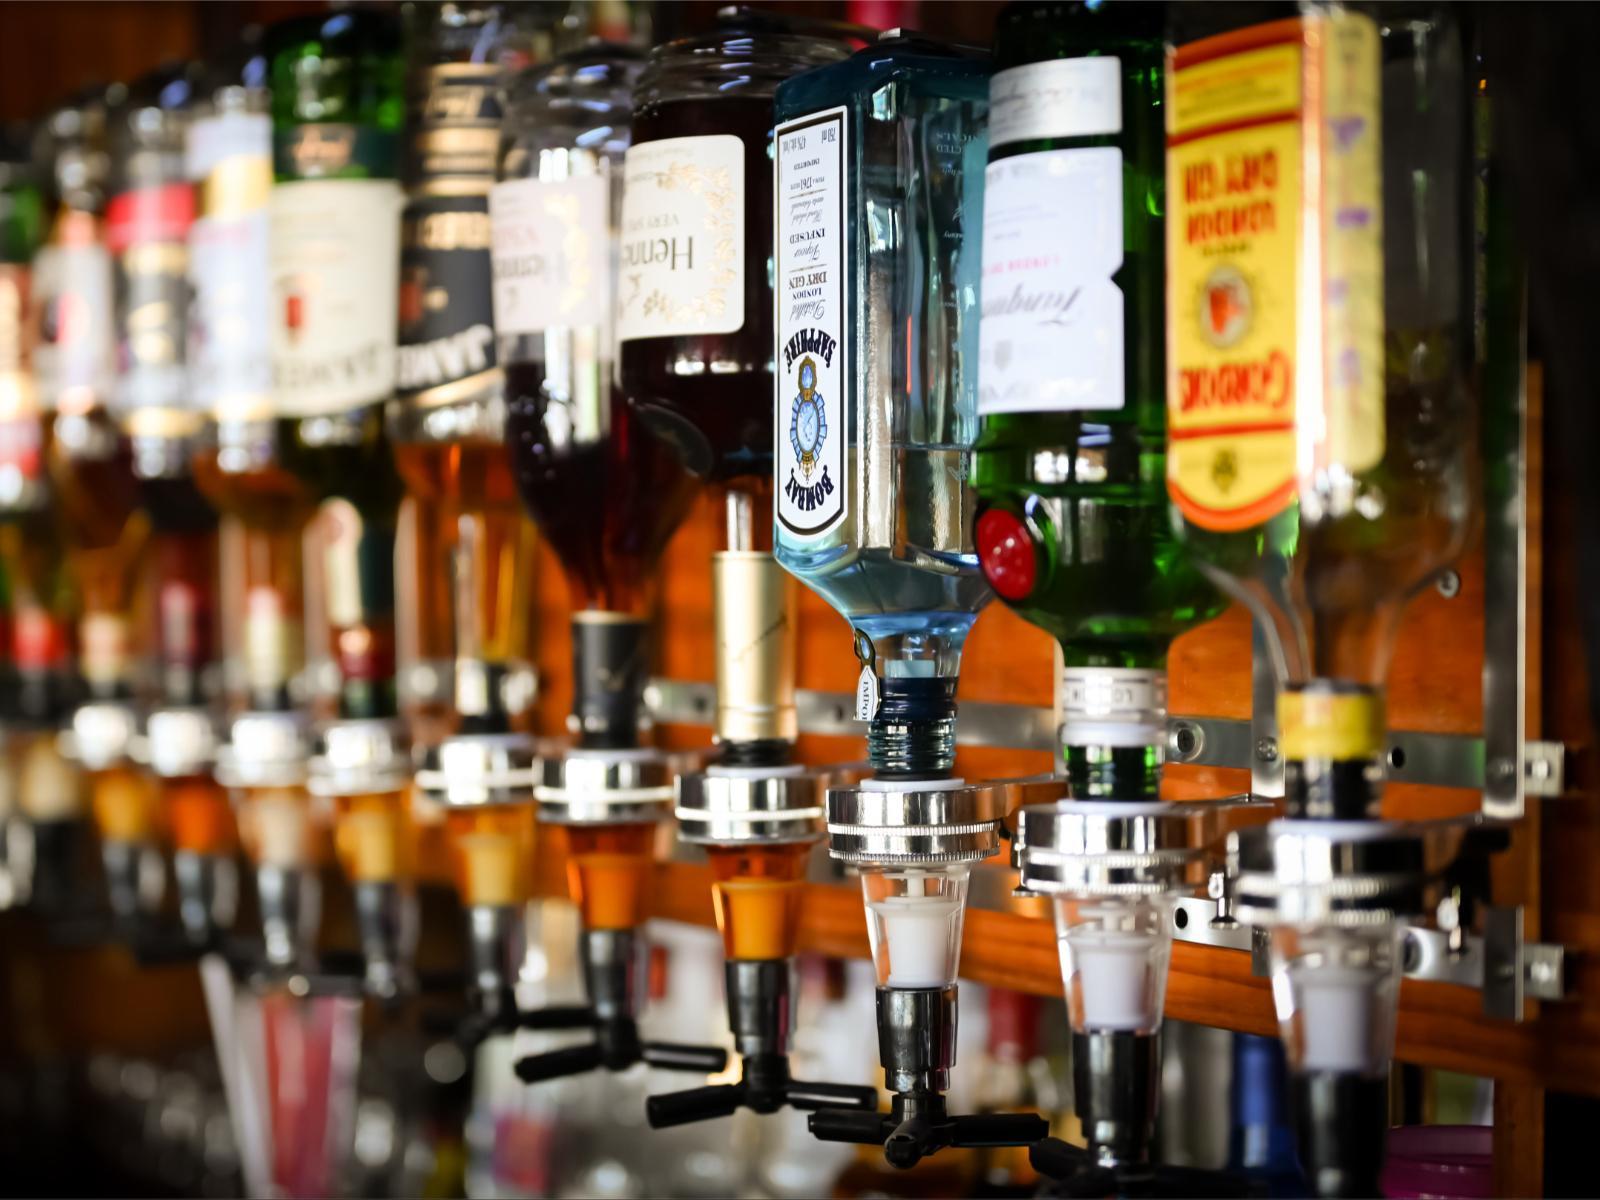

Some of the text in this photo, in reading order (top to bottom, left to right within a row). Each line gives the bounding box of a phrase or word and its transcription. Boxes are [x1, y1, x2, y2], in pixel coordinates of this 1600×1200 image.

[800, 176, 813, 190] 1761
[1183, 150, 1279, 205] DRY GIN
[789, 228, 825, 244] INFUSED
[1186, 200, 1277, 244] LONDON
[788, 271, 827, 290] DRY GIN
[792, 287, 822, 300] LONDON
[784, 328, 836, 374] SAPPHIRE
[785, 465, 834, 512] BOMBAY
